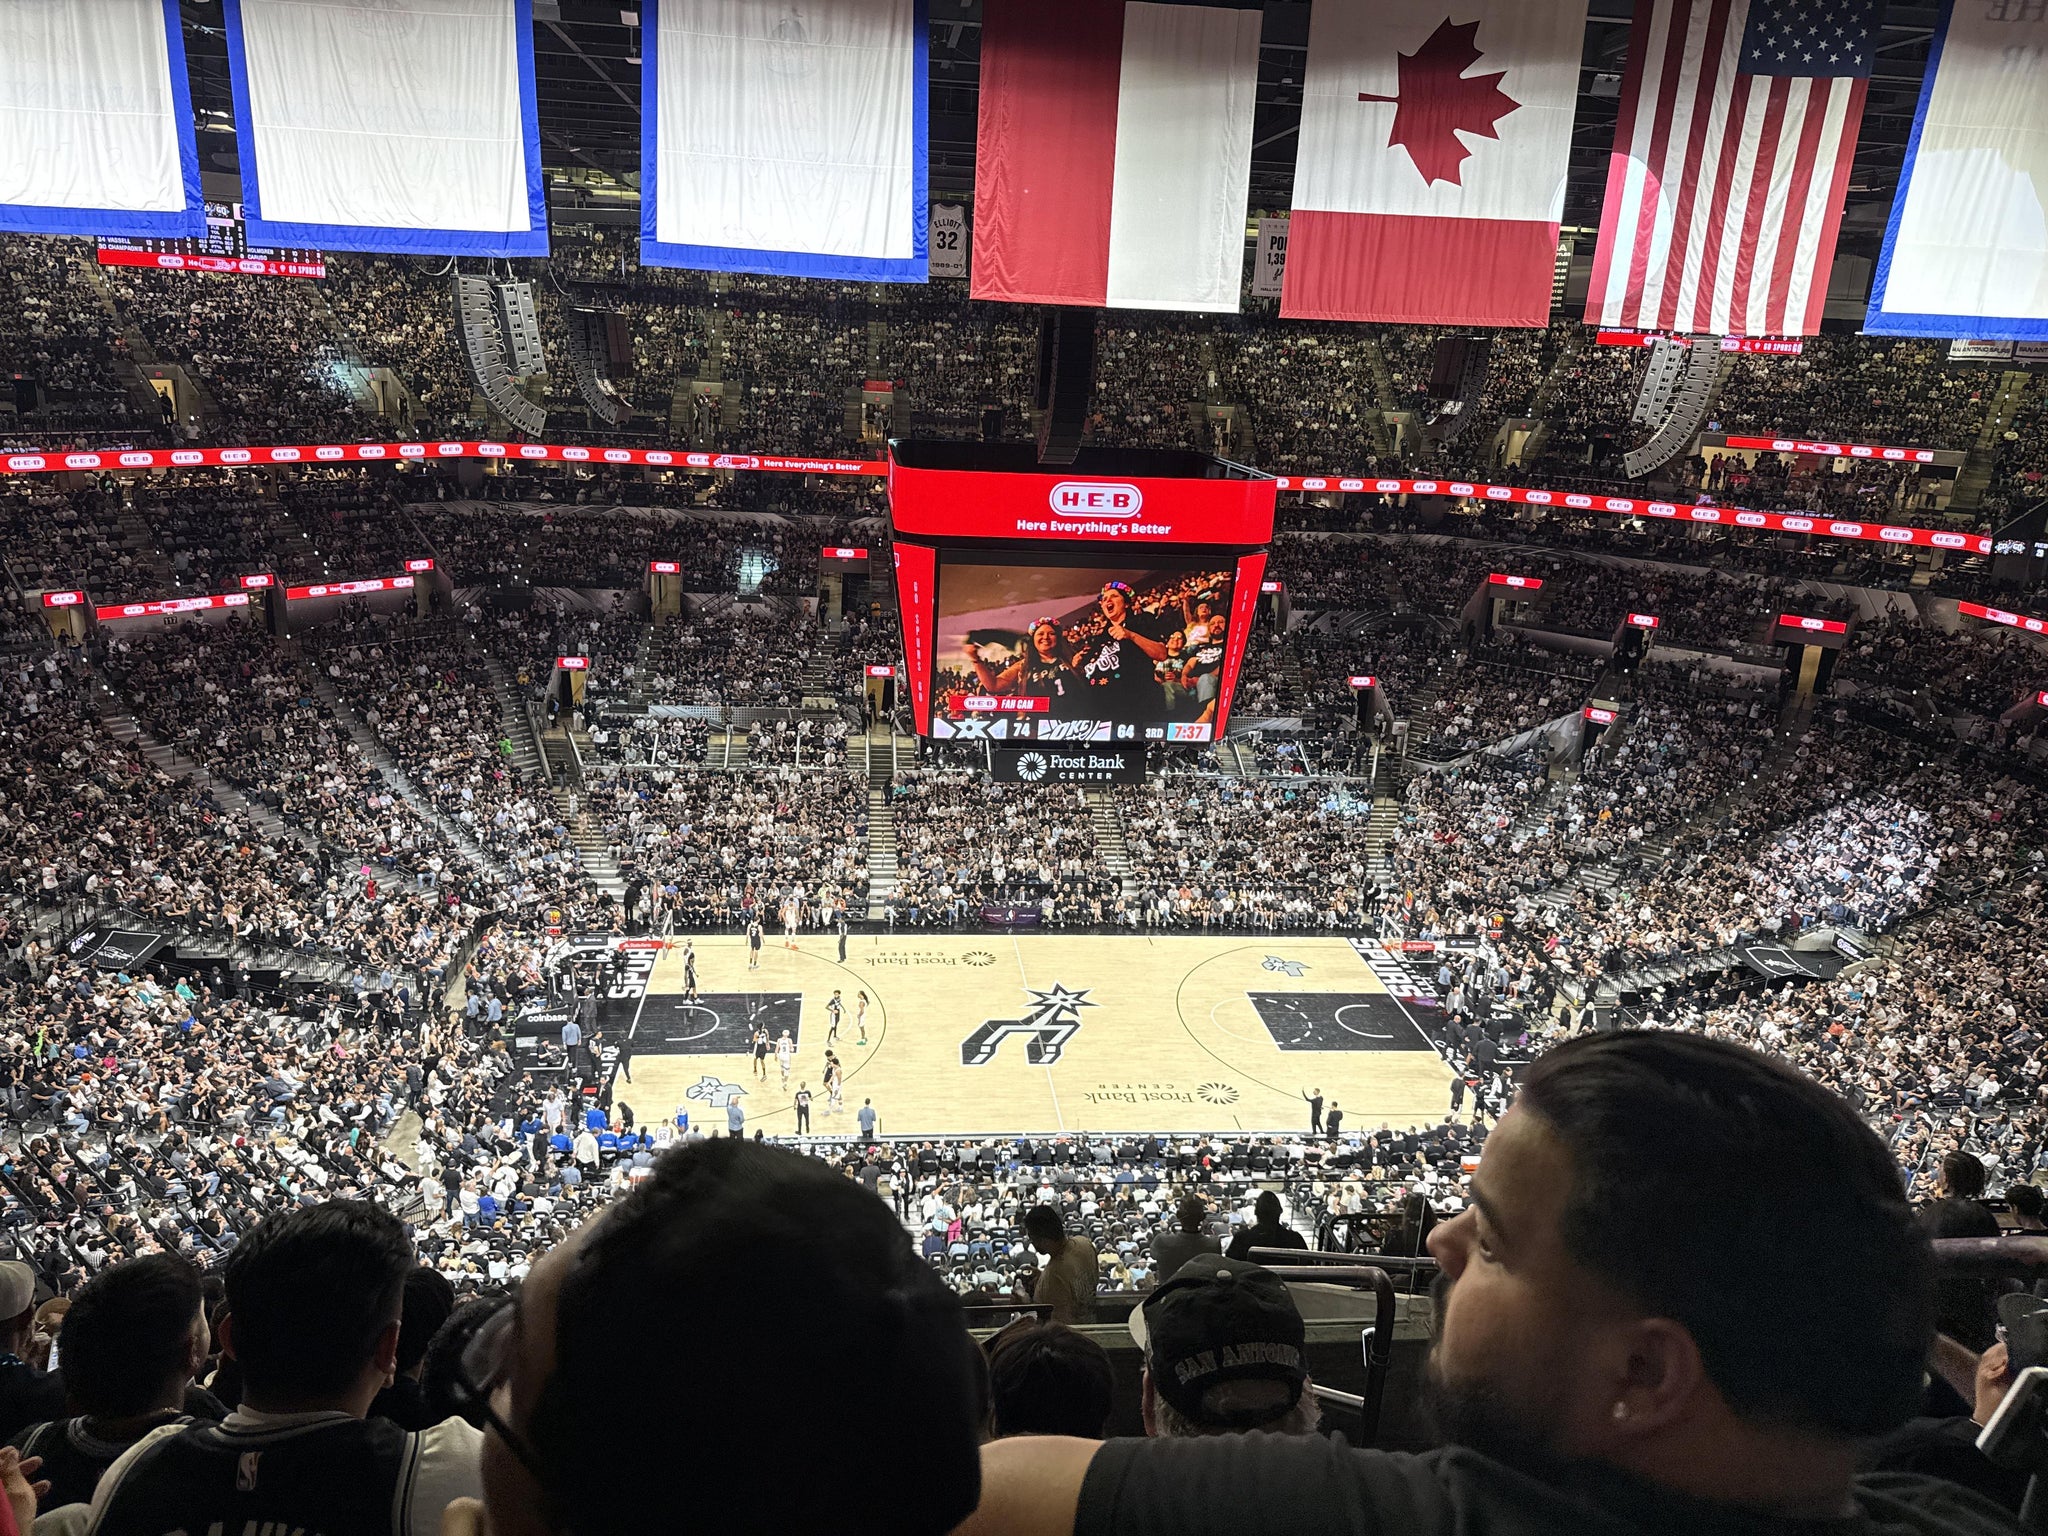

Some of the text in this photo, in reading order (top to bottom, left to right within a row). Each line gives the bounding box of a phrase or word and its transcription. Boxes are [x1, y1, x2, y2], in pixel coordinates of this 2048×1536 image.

[934, 219, 962, 230] ELLIOTT
[936, 230, 958, 250] 32
[1267, 252, 1286, 266] 1,39
[764, 459, 862, 471] Here Everything's Better
[1062, 491, 1131, 508] H-E-B
[1016, 519, 1171, 536] Here Everything's Better
[1001, 699, 1018, 709] FAN
[1018, 700, 1034, 710] CAM
[1013, 722, 1031, 737] 74
[1117, 724, 1135, 739] 64
[1145, 727, 1163, 738] 3RD
[1174, 725, 1204, 739] 7:37
[1050, 753, 1125, 769] Frost Bank
[1059, 772, 1112, 780] CENTER
[864, 957, 958, 967] Frost Bank
[1349, 937, 1425, 998] SPURS
[527, 1013, 568, 1022] coinbase
[1082, 1092, 1194, 1104] Frost Bank
[1175, 1350, 1218, 1385] SAN
